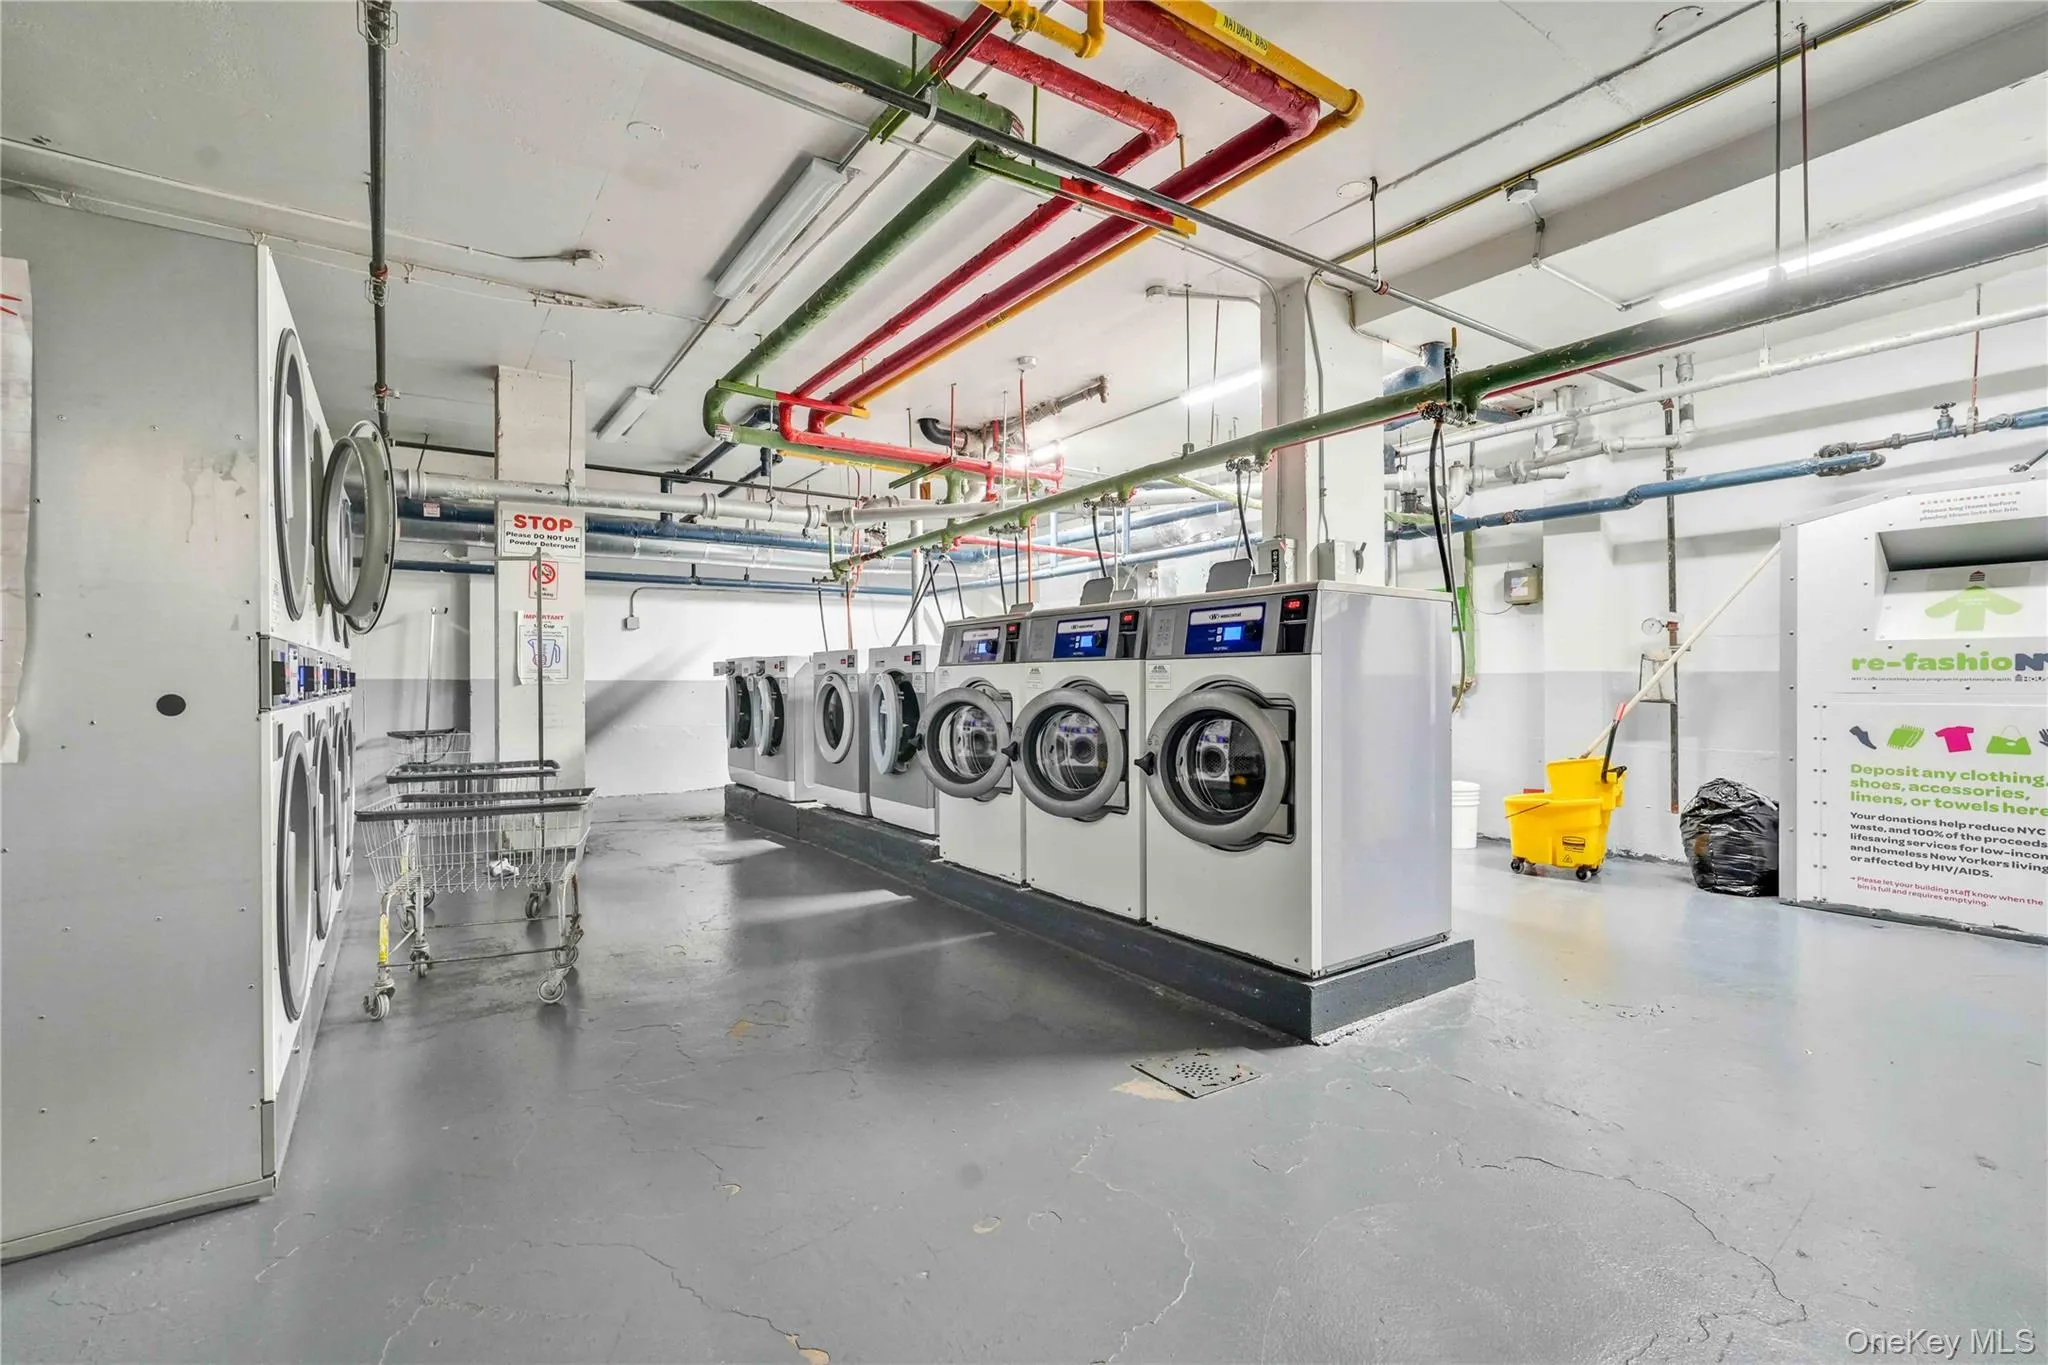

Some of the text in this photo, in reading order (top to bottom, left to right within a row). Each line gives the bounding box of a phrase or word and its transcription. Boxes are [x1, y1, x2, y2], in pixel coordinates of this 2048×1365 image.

[513, 514, 573, 532] STOP
[505, 530, 532, 539] Please
[509, 539, 577, 550] Powder Detergent
[1851, 763, 1919, 777] Deposit
[1922, 769, 1957, 782] any
[1850, 777, 2031, 801] shoes, accessories,
[1850, 791, 1908, 807] linens,
[1910, 798, 1931, 807] or
[1934, 798, 1999, 813] towels
[1850, 811, 2047, 836] Your donations help reduce NYC
[1850, 823, 1887, 833] waste,
[1888, 827, 1911, 835] and
[1912, 828, 1944, 838] 100%
[1960, 833, 1982, 842] the
[1984, 836, 2048, 848] proceeds
[1850, 832, 1906, 847] lifesaving
[1906, 840, 1957, 851] services
[1959, 844, 1979, 853] for
[1850, 845, 2048, 875] and homeless New Yorkers living
[1863, 856, 1913, 868] affected
[1914, 861, 1930, 872] by
[1931, 864, 1993, 878] HIV/AIDS.
[1856, 876, 1882, 885] Please
[1914, 883, 1949, 894] building
[1950, 888, 1970, 897] staff
[1971, 890, 1998, 900] know
[1998, 895, 2026, 904] when
[2026, 898, 2044, 906] the
[1892, 888, 1907, 896] and
[1908, 891, 1943, 901] requires
[1944, 896, 1989, 907] emptying.
